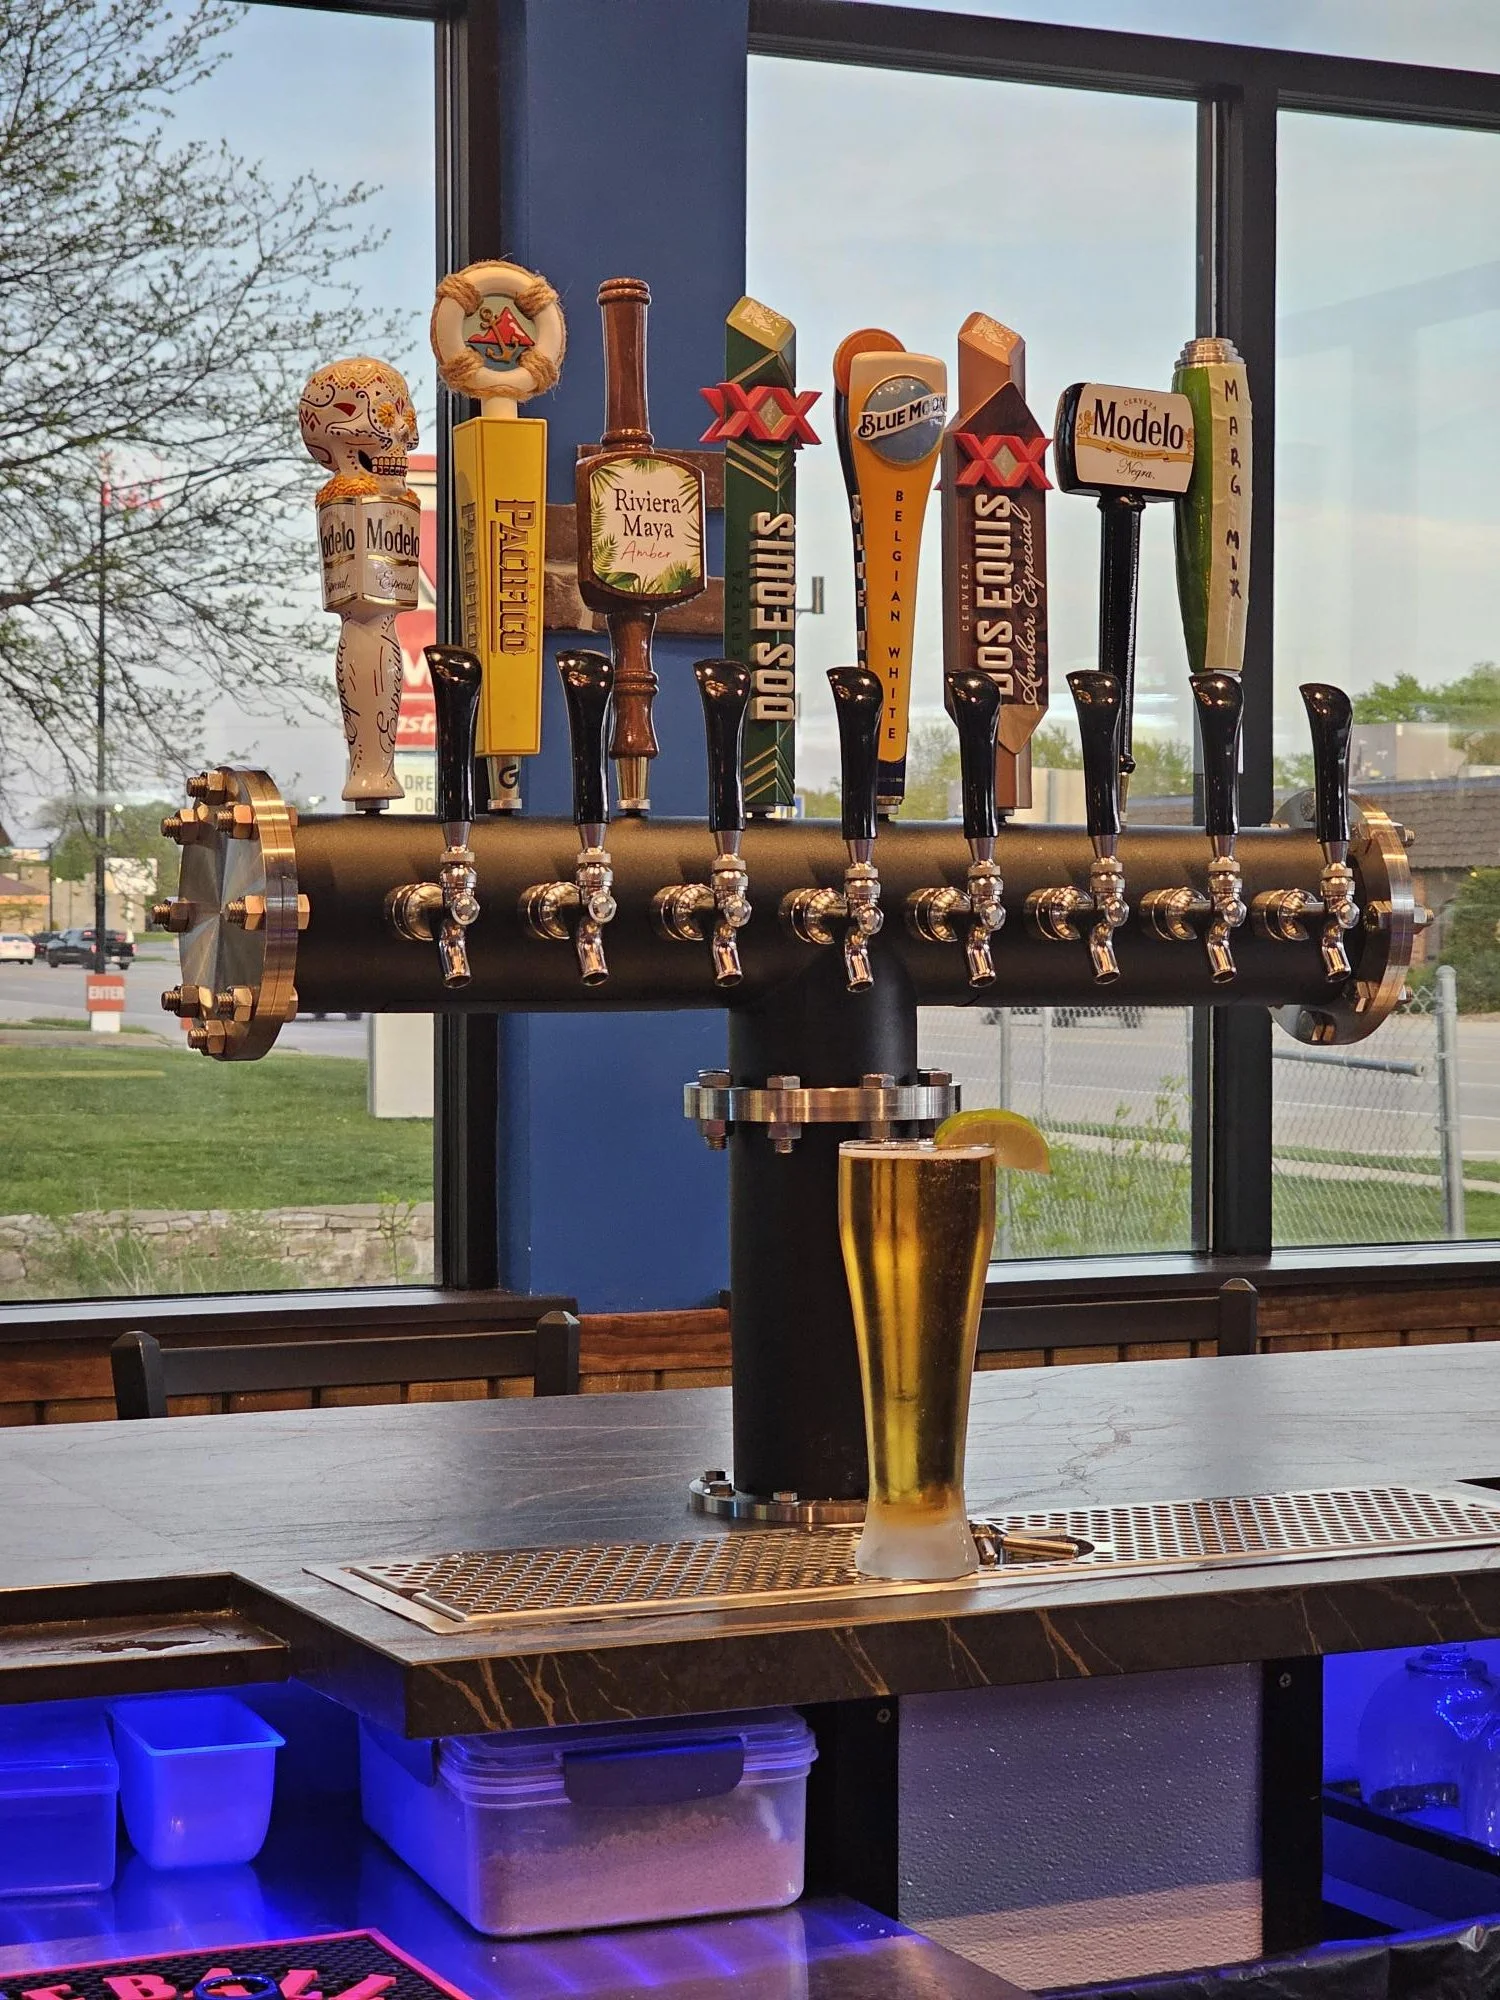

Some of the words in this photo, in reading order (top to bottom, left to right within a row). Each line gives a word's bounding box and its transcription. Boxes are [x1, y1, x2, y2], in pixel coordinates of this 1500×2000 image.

[858, 408, 906, 438] BLUE
[1093, 398, 1184, 450] Modelo
[1225, 378, 1242, 497] MARG
[366, 517, 420, 558] Modelo
[614, 488, 682, 514] Riviera
[622, 513, 675, 541] Maya
[495, 498, 537, 656] PACIFICO
[620, 540, 672, 564] Amber
[751, 511, 797, 631] EQUIS
[889, 490, 904, 622] BELGIAN
[974, 493, 1015, 609] EQUIS
[1010, 501, 1045, 608] Especial
[961, 562, 969, 632] CERVEZA
[751, 642, 796, 721] DOS
[888, 647, 901, 740] WHITE
[1015, 612, 1043, 711] Ambar
